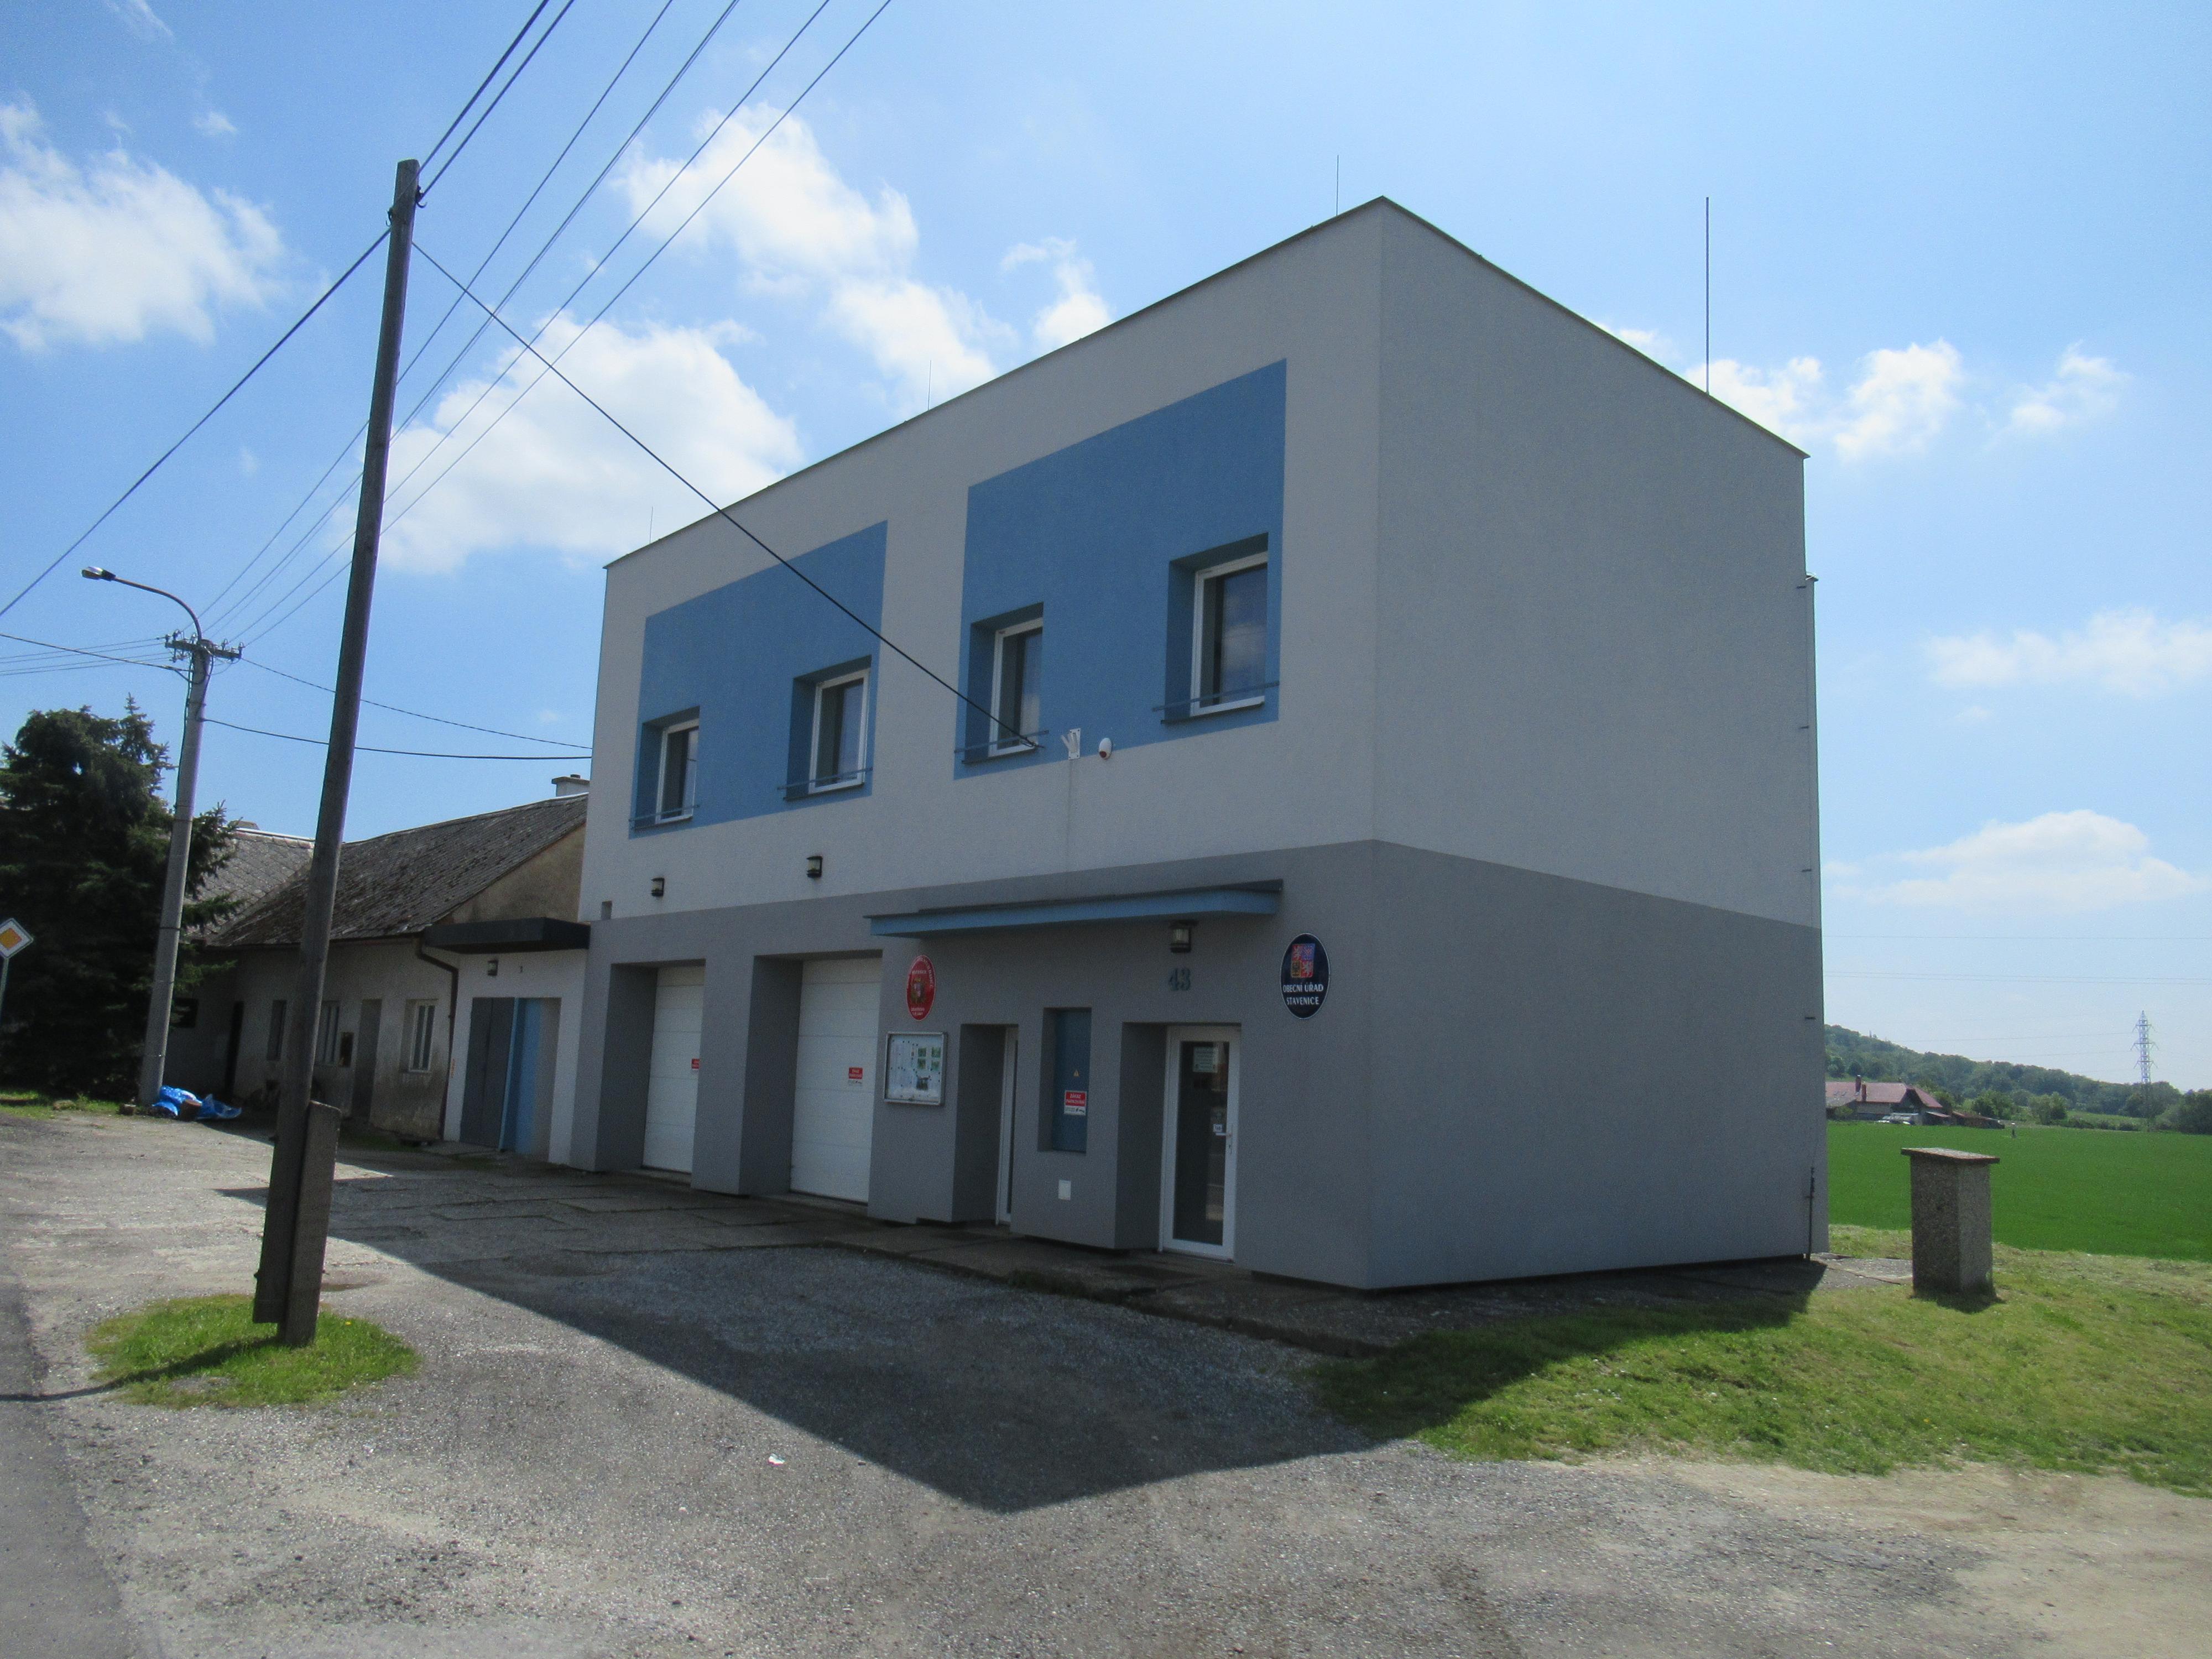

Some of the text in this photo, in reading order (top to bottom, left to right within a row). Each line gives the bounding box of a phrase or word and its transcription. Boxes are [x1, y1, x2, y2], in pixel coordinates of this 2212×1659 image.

[1168, 968, 1191, 992] 43
[1283, 982, 1324, 993] OBECNÍ ÚŘAD
[1287, 997, 1319, 1005] STAVENICE
